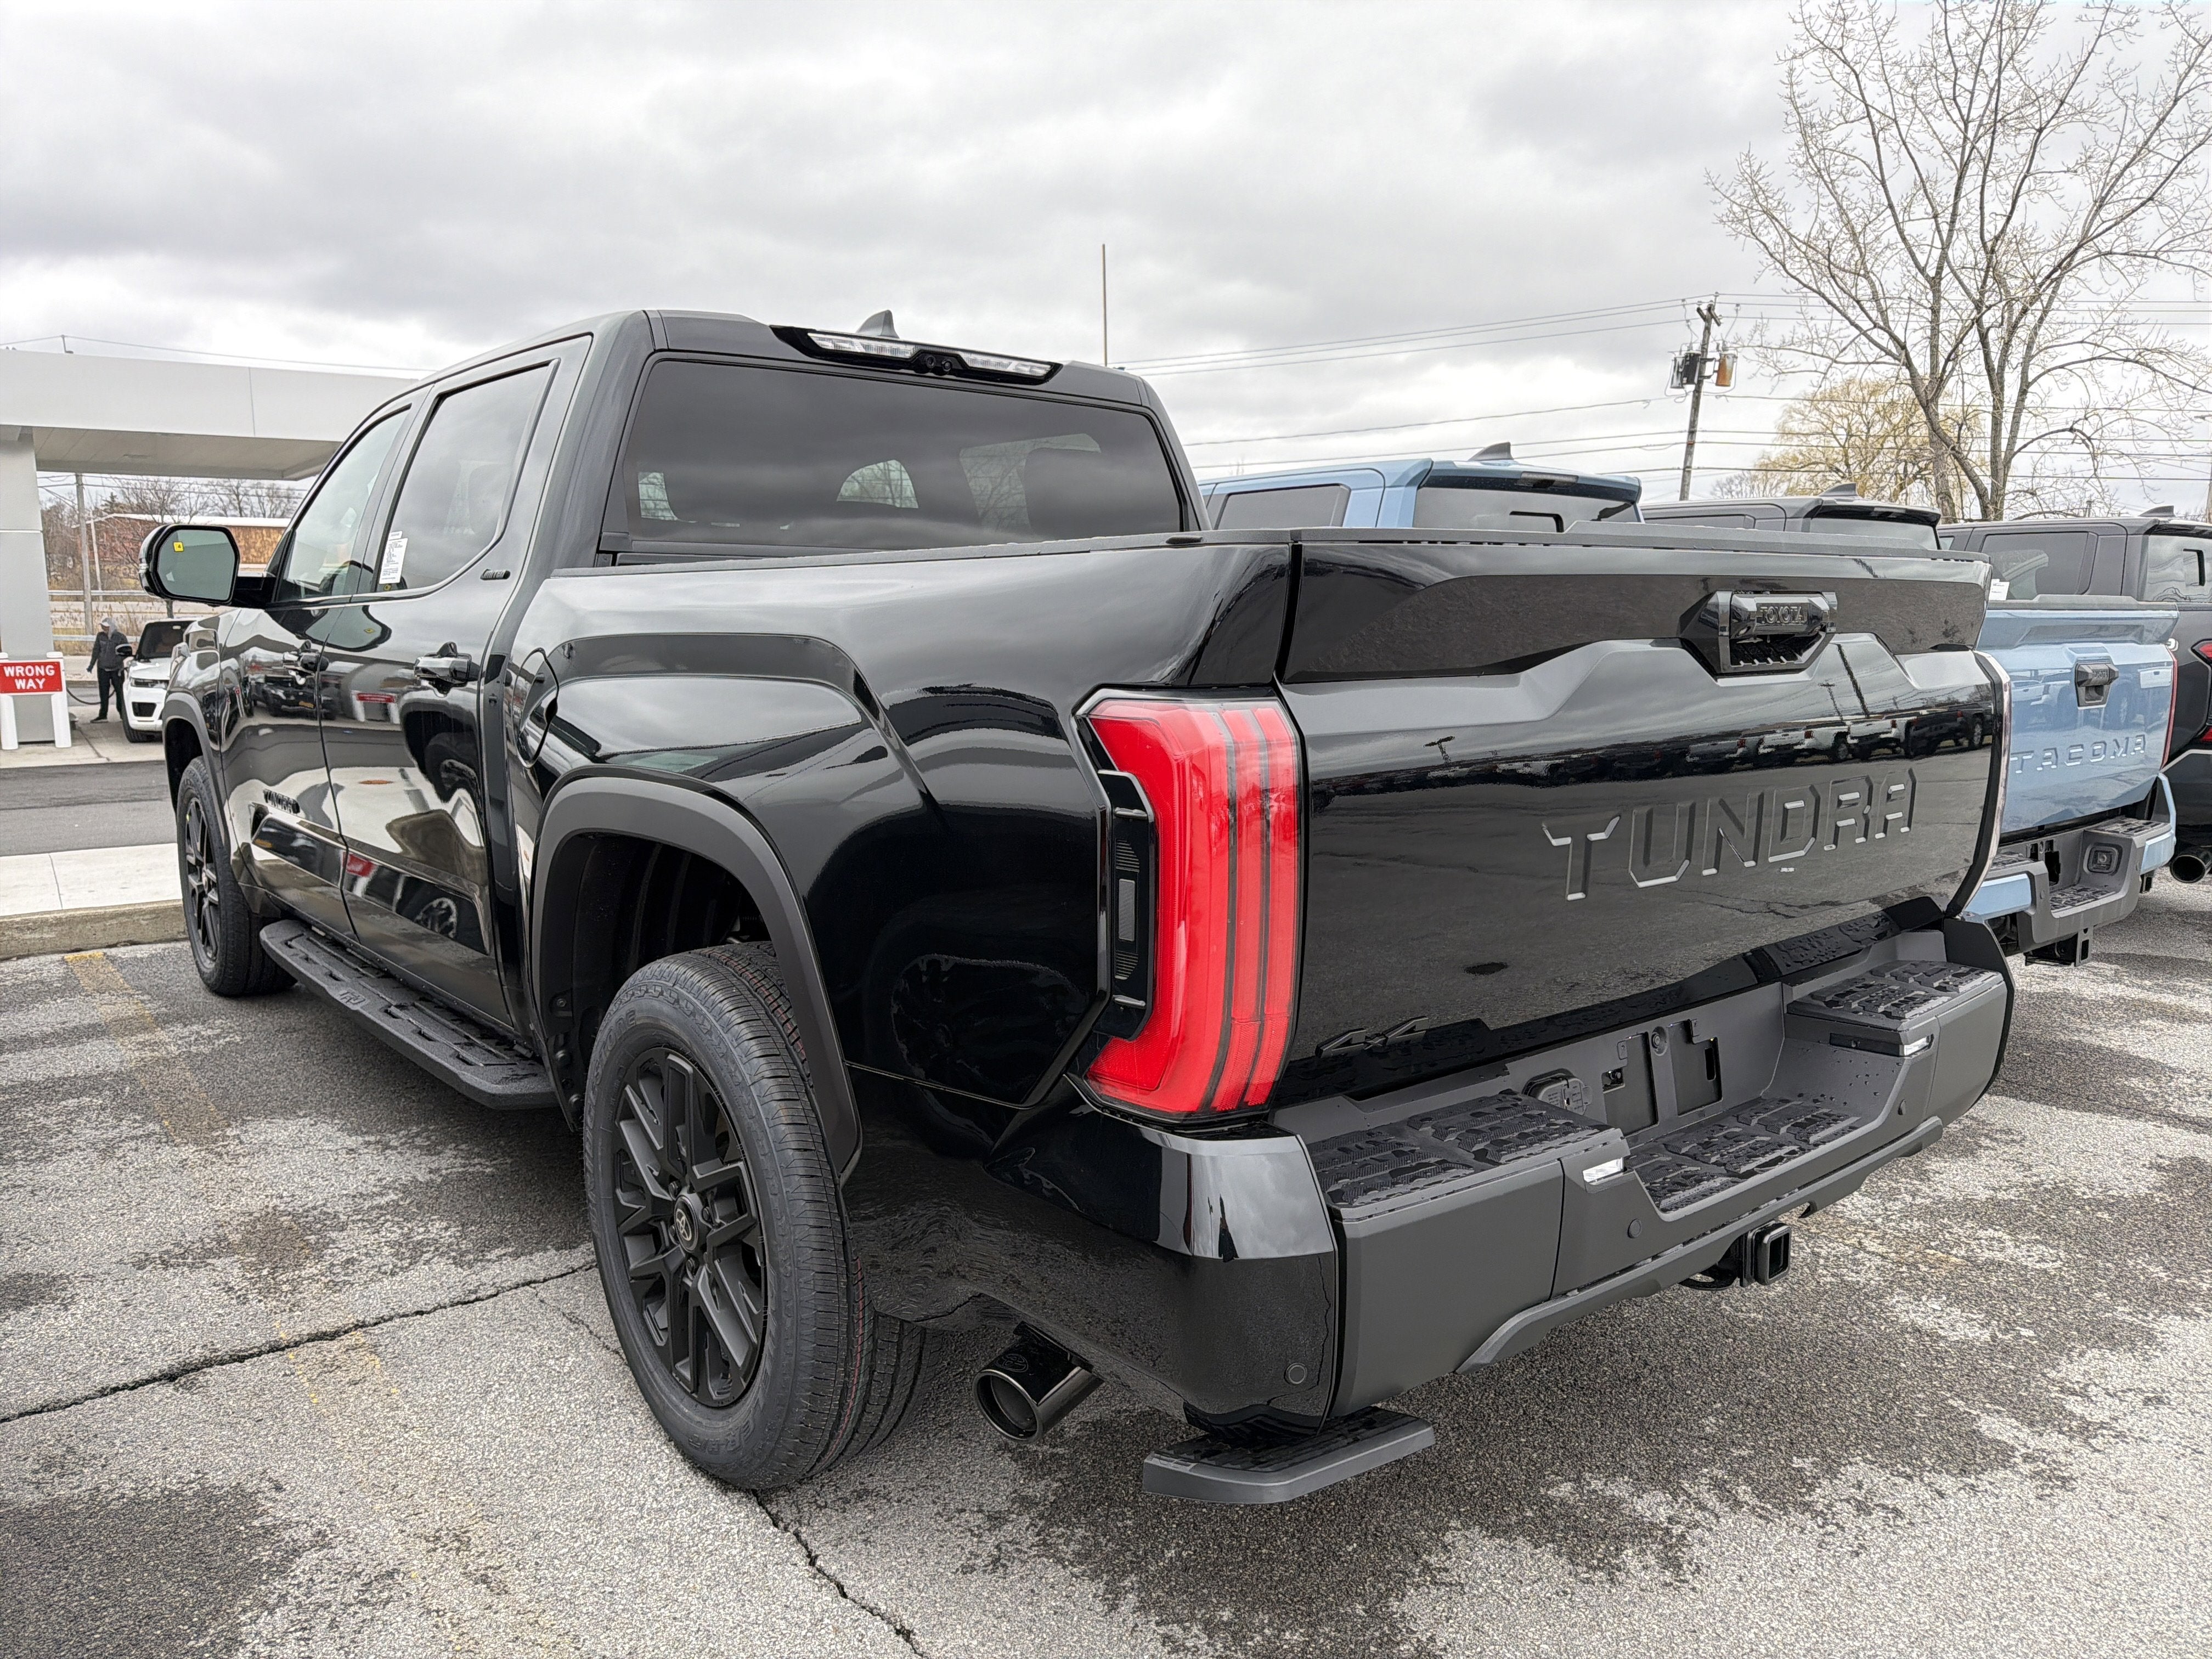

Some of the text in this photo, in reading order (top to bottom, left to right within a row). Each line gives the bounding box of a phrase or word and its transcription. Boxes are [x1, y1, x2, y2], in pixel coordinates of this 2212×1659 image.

[1760, 606, 1805, 624] TOYOTA
[3, 665, 55, 677] WRONG
[14, 678, 46, 690] WAY
[2010, 734, 2146, 774] TACOMA
[1542, 768, 1917, 901] TUNDRA
